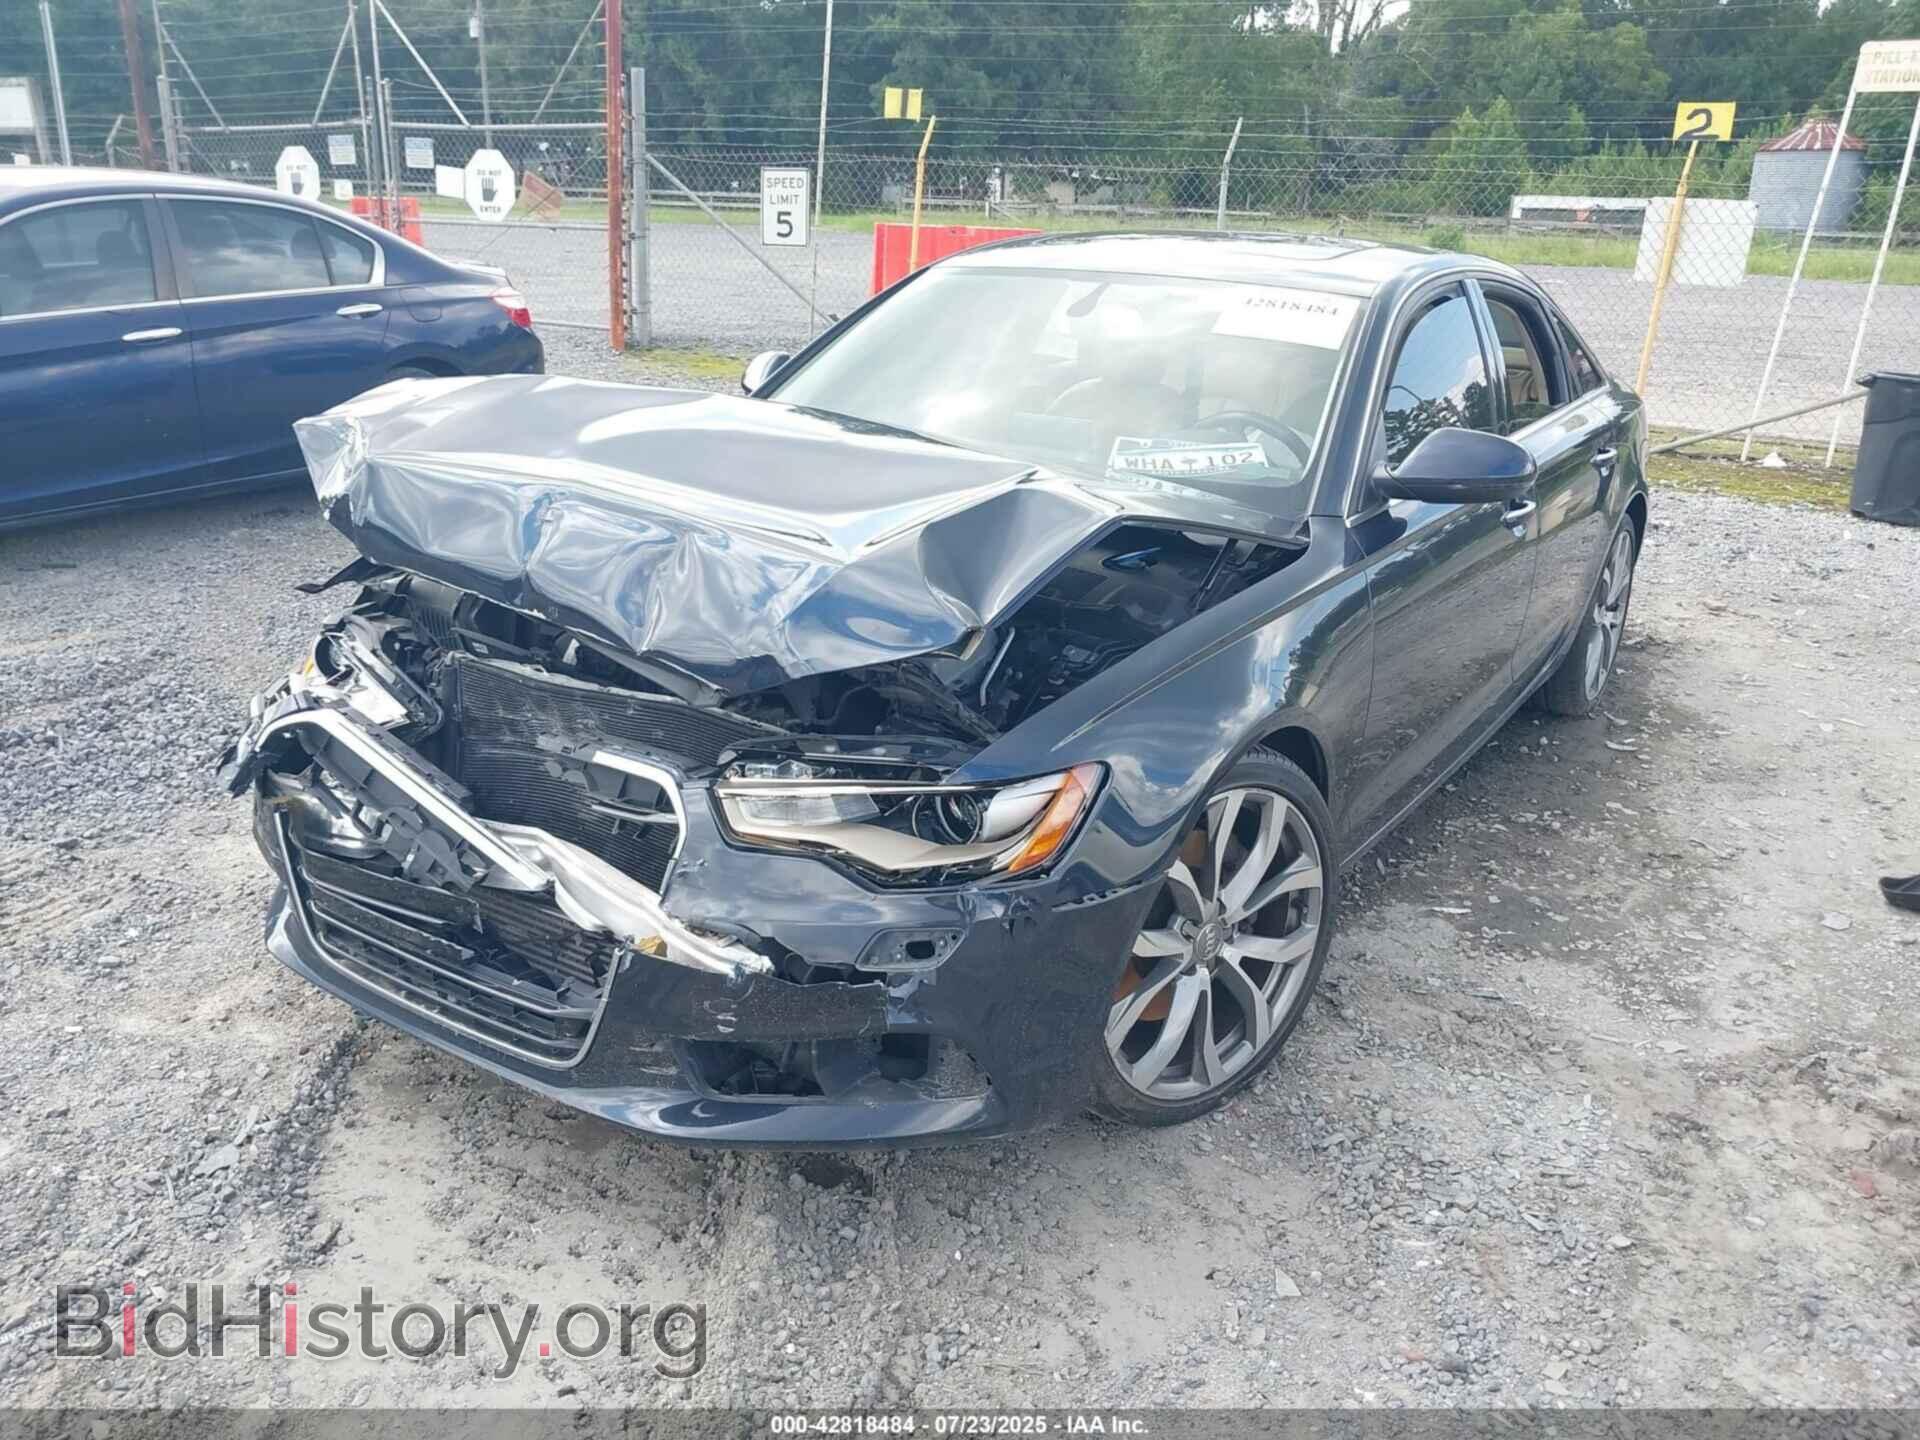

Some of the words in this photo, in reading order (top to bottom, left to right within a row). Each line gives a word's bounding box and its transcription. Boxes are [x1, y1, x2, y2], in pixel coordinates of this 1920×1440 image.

[1678, 108, 1720, 140] 2
[766, 177, 804, 189] SPEED
[769, 194, 800, 206] LIMIT
[480, 205, 501, 213] ENTER
[776, 211, 793, 238] 5
[1123, 457, 1174, 470] WHA
[1207, 452, 1254, 467] 102
